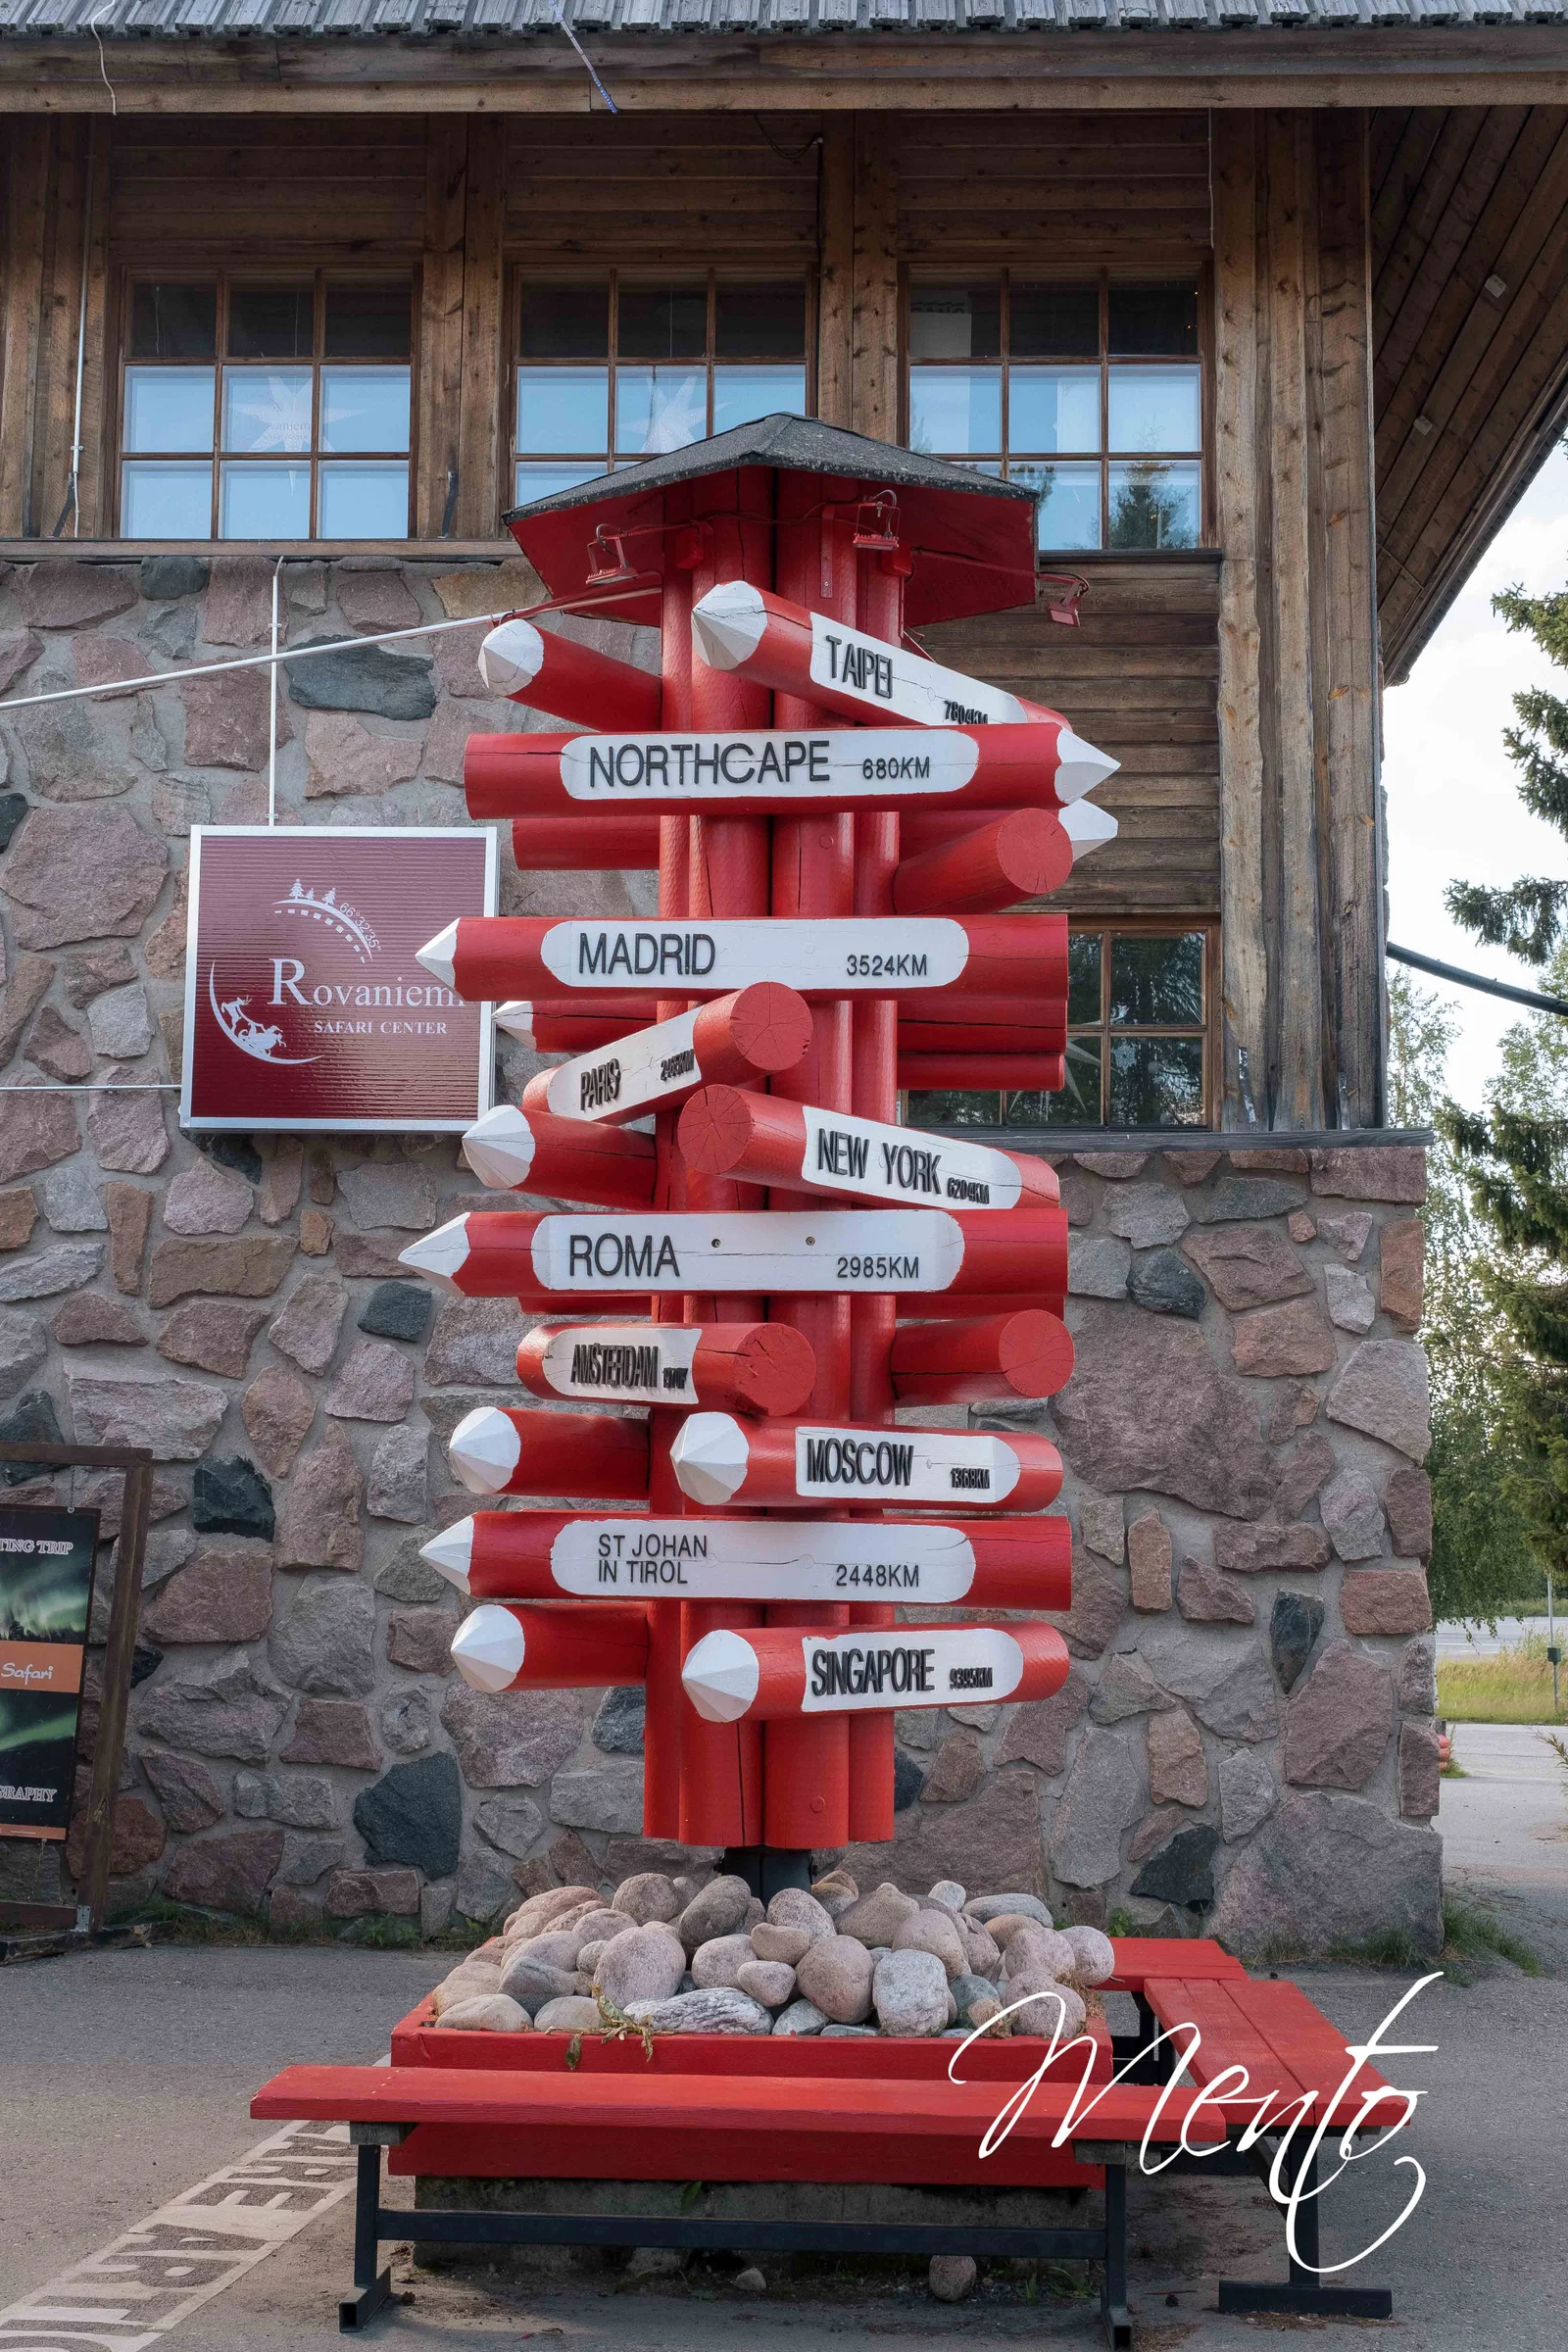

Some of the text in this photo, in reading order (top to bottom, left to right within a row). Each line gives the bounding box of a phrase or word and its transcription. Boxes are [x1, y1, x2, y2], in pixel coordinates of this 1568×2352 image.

[825, 634, 894, 699] TAIPEI
[590, 740, 930, 788] NORTHCAPE 680KM
[578, 932, 928, 977] MADRID 3524KM
[267, 957, 466, 1007] Rovaniem
[314, 1020, 448, 1035] SAFARI CENTER
[580, 1057, 621, 1111] PARIS
[817, 1128, 990, 1205] NEW YORK 6204KM
[568, 1234, 919, 1280] ROMA 2985KM
[570, 1342, 659, 1388] AMSTERDAM
[807, 1437, 991, 1490] MOSCOW 1368KM
[36, 1540, 74, 1555] TRIP
[598, 1533, 708, 1557] ST JOHAN
[598, 1559, 689, 1585] IN TIROL
[835, 1563, 920, 1589] 2448KM
[0, 1661, 54, 1686] Safari
[811, 1646, 936, 1696] SINGAPORE
